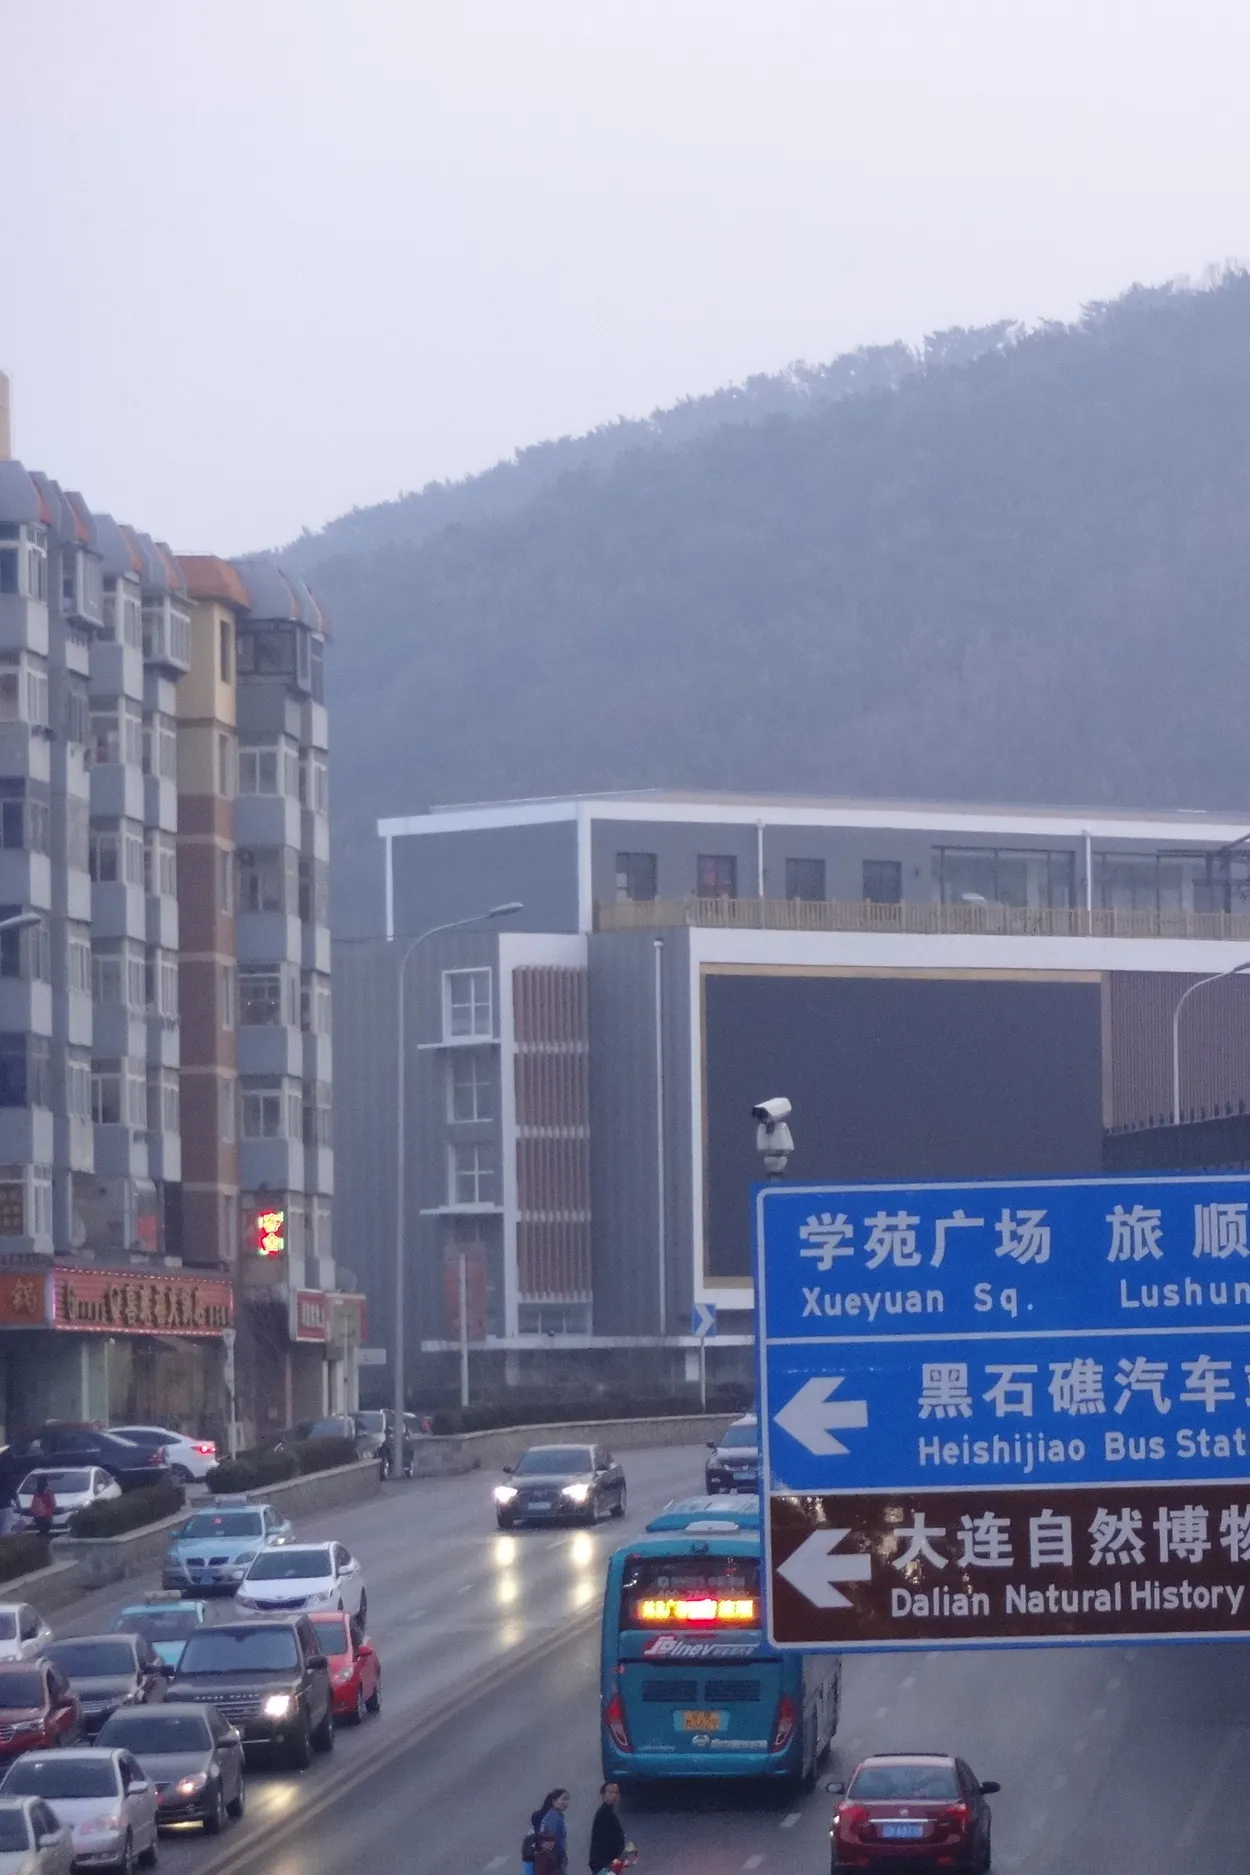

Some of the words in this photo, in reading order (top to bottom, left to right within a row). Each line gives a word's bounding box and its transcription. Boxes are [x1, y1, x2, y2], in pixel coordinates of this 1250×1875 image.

[800, 1208, 1050, 1271] 学苑广场
[1106, 1203, 1250, 1262] 旅顺
[802, 1287, 944, 1322] Xueyuan
[974, 1282, 1034, 1318] Sq.
[918, 1433, 1086, 1473] Heishijiao
[1104, 1431, 1165, 1461] Bus
[891, 1586, 990, 1618] Dalian
[1005, 1582, 1121, 1614] Natural
[1130, 1579, 1245, 1614] History
